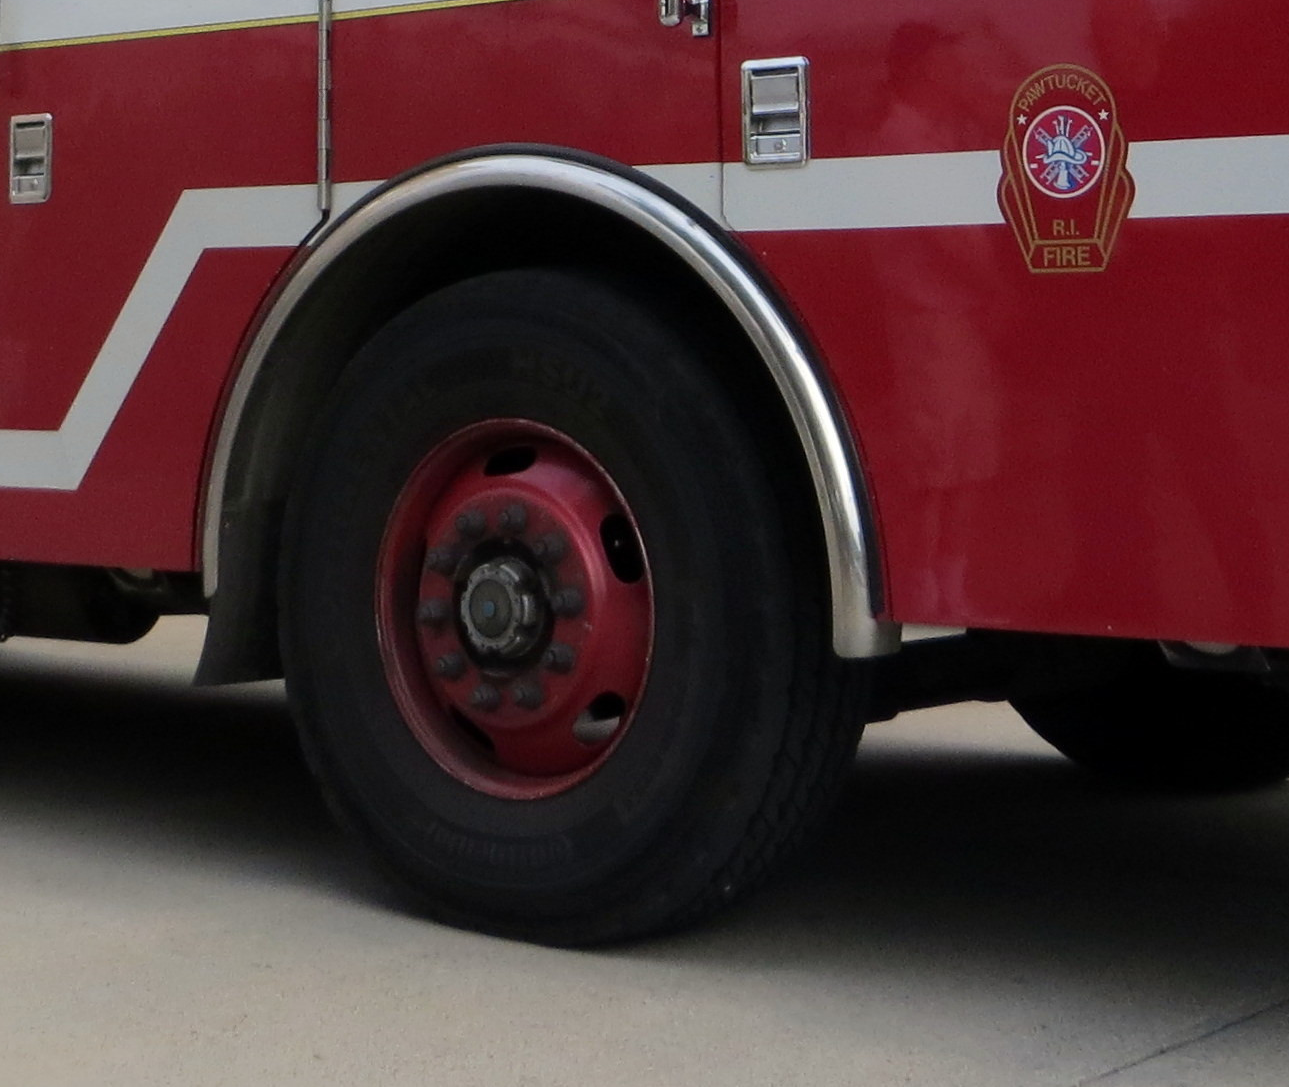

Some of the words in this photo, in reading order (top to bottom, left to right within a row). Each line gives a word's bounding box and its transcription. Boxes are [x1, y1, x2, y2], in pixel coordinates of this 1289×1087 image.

[1017, 72, 1107, 113] PAWTUCKET
[1052, 219, 1080, 236] R.I.
[1043, 245, 1091, 268] FIRE
